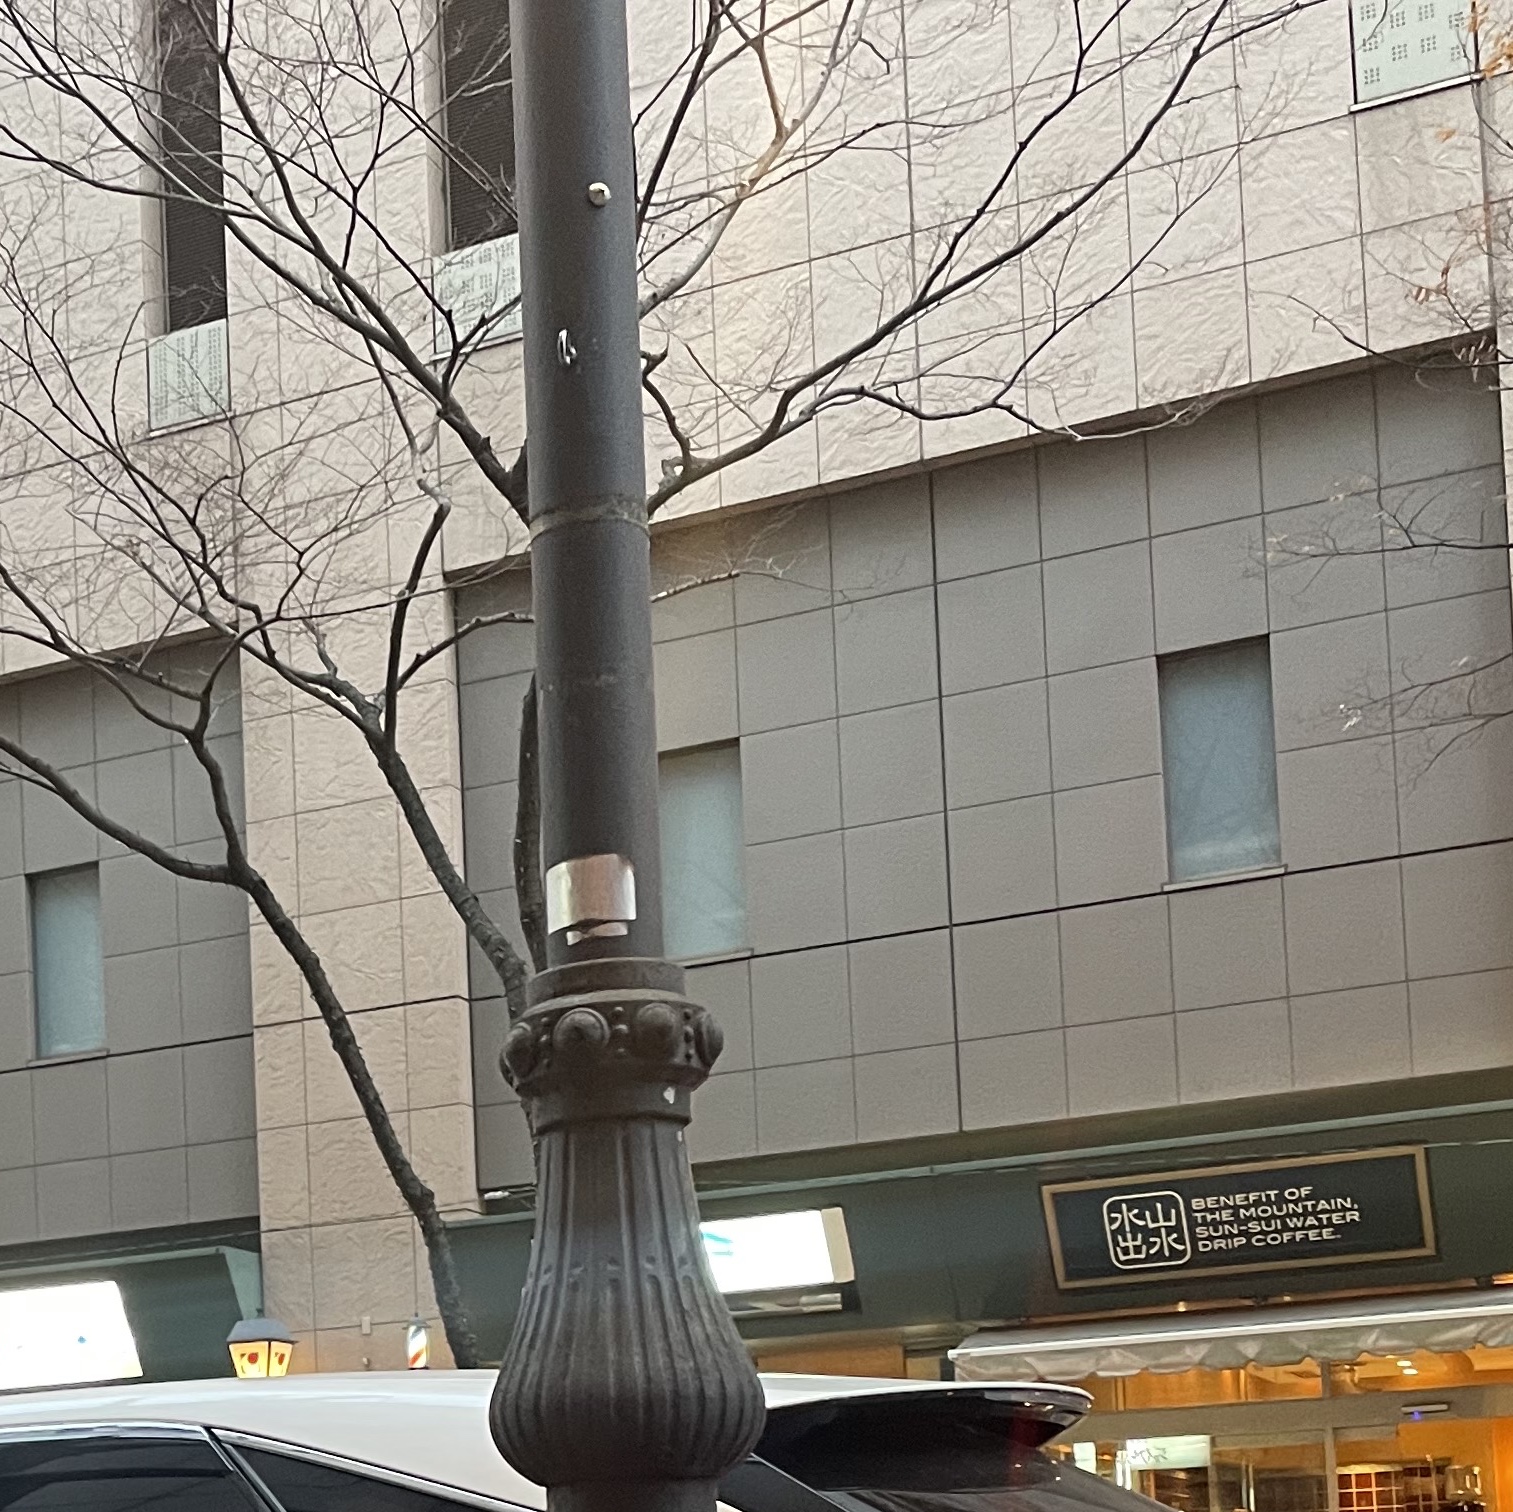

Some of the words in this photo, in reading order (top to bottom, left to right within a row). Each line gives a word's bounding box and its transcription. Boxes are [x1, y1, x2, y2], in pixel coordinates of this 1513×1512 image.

[1191, 1190, 1279, 1210] BENEFIT
[1284, 1186, 1313, 1200] OF
[1192, 1209, 1235, 1224] THE
[1195, 1219, 1282, 1238] SUN-SUI
[1286, 1211, 1361, 1228] WATER
[1198, 1236, 1247, 1252] DRIP
